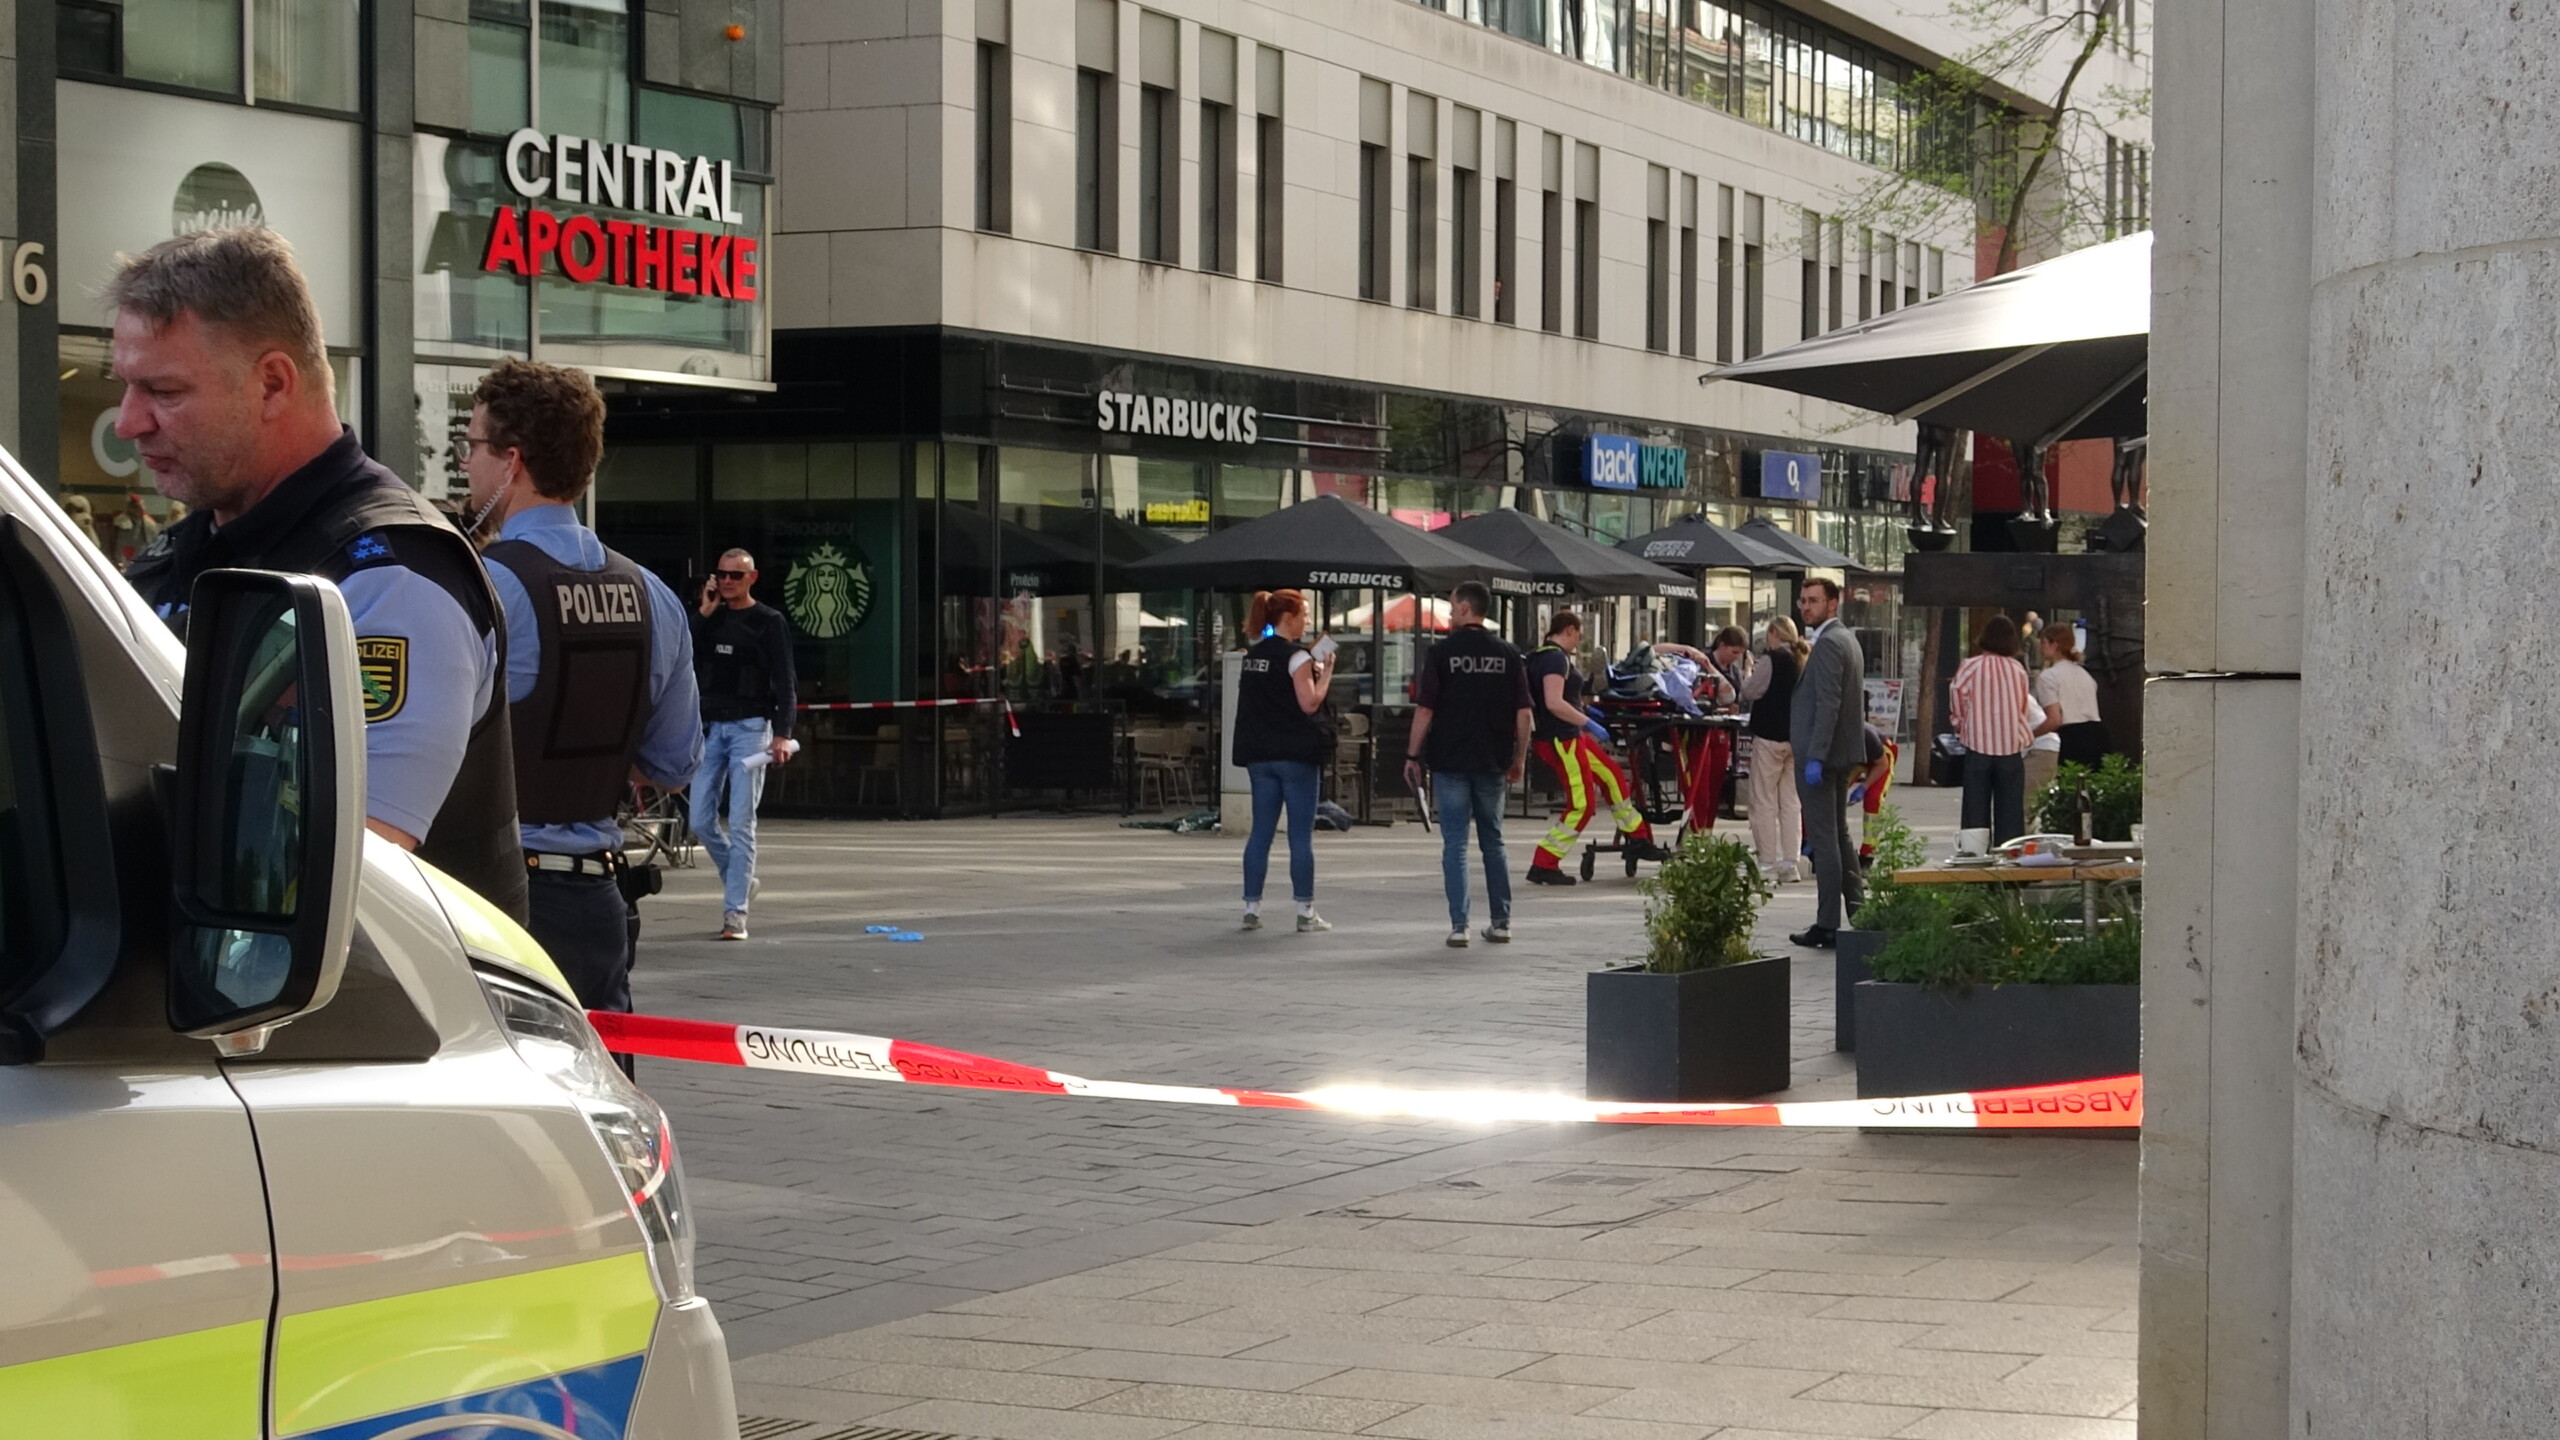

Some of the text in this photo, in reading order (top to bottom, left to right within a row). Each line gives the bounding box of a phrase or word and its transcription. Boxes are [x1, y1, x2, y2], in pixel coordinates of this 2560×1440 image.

[506, 127, 743, 225] CENTRAL
[0, 241, 48, 306] 6
[485, 205, 758, 302] APOTHEKE
[1096, 390, 1258, 445] STARBUCKS
[1593, 437, 1687, 488] back WERK
[1308, 570, 1404, 589] STARBUCKS
[1491, 577, 1532, 595] STARBUCKS
[556, 583, 642, 625] POLIZEI
[357, 644, 400, 660] OLIZEI
[1243, 658, 1270, 672] OLIZEI
[1449, 656, 1507, 675] POLIZEI
